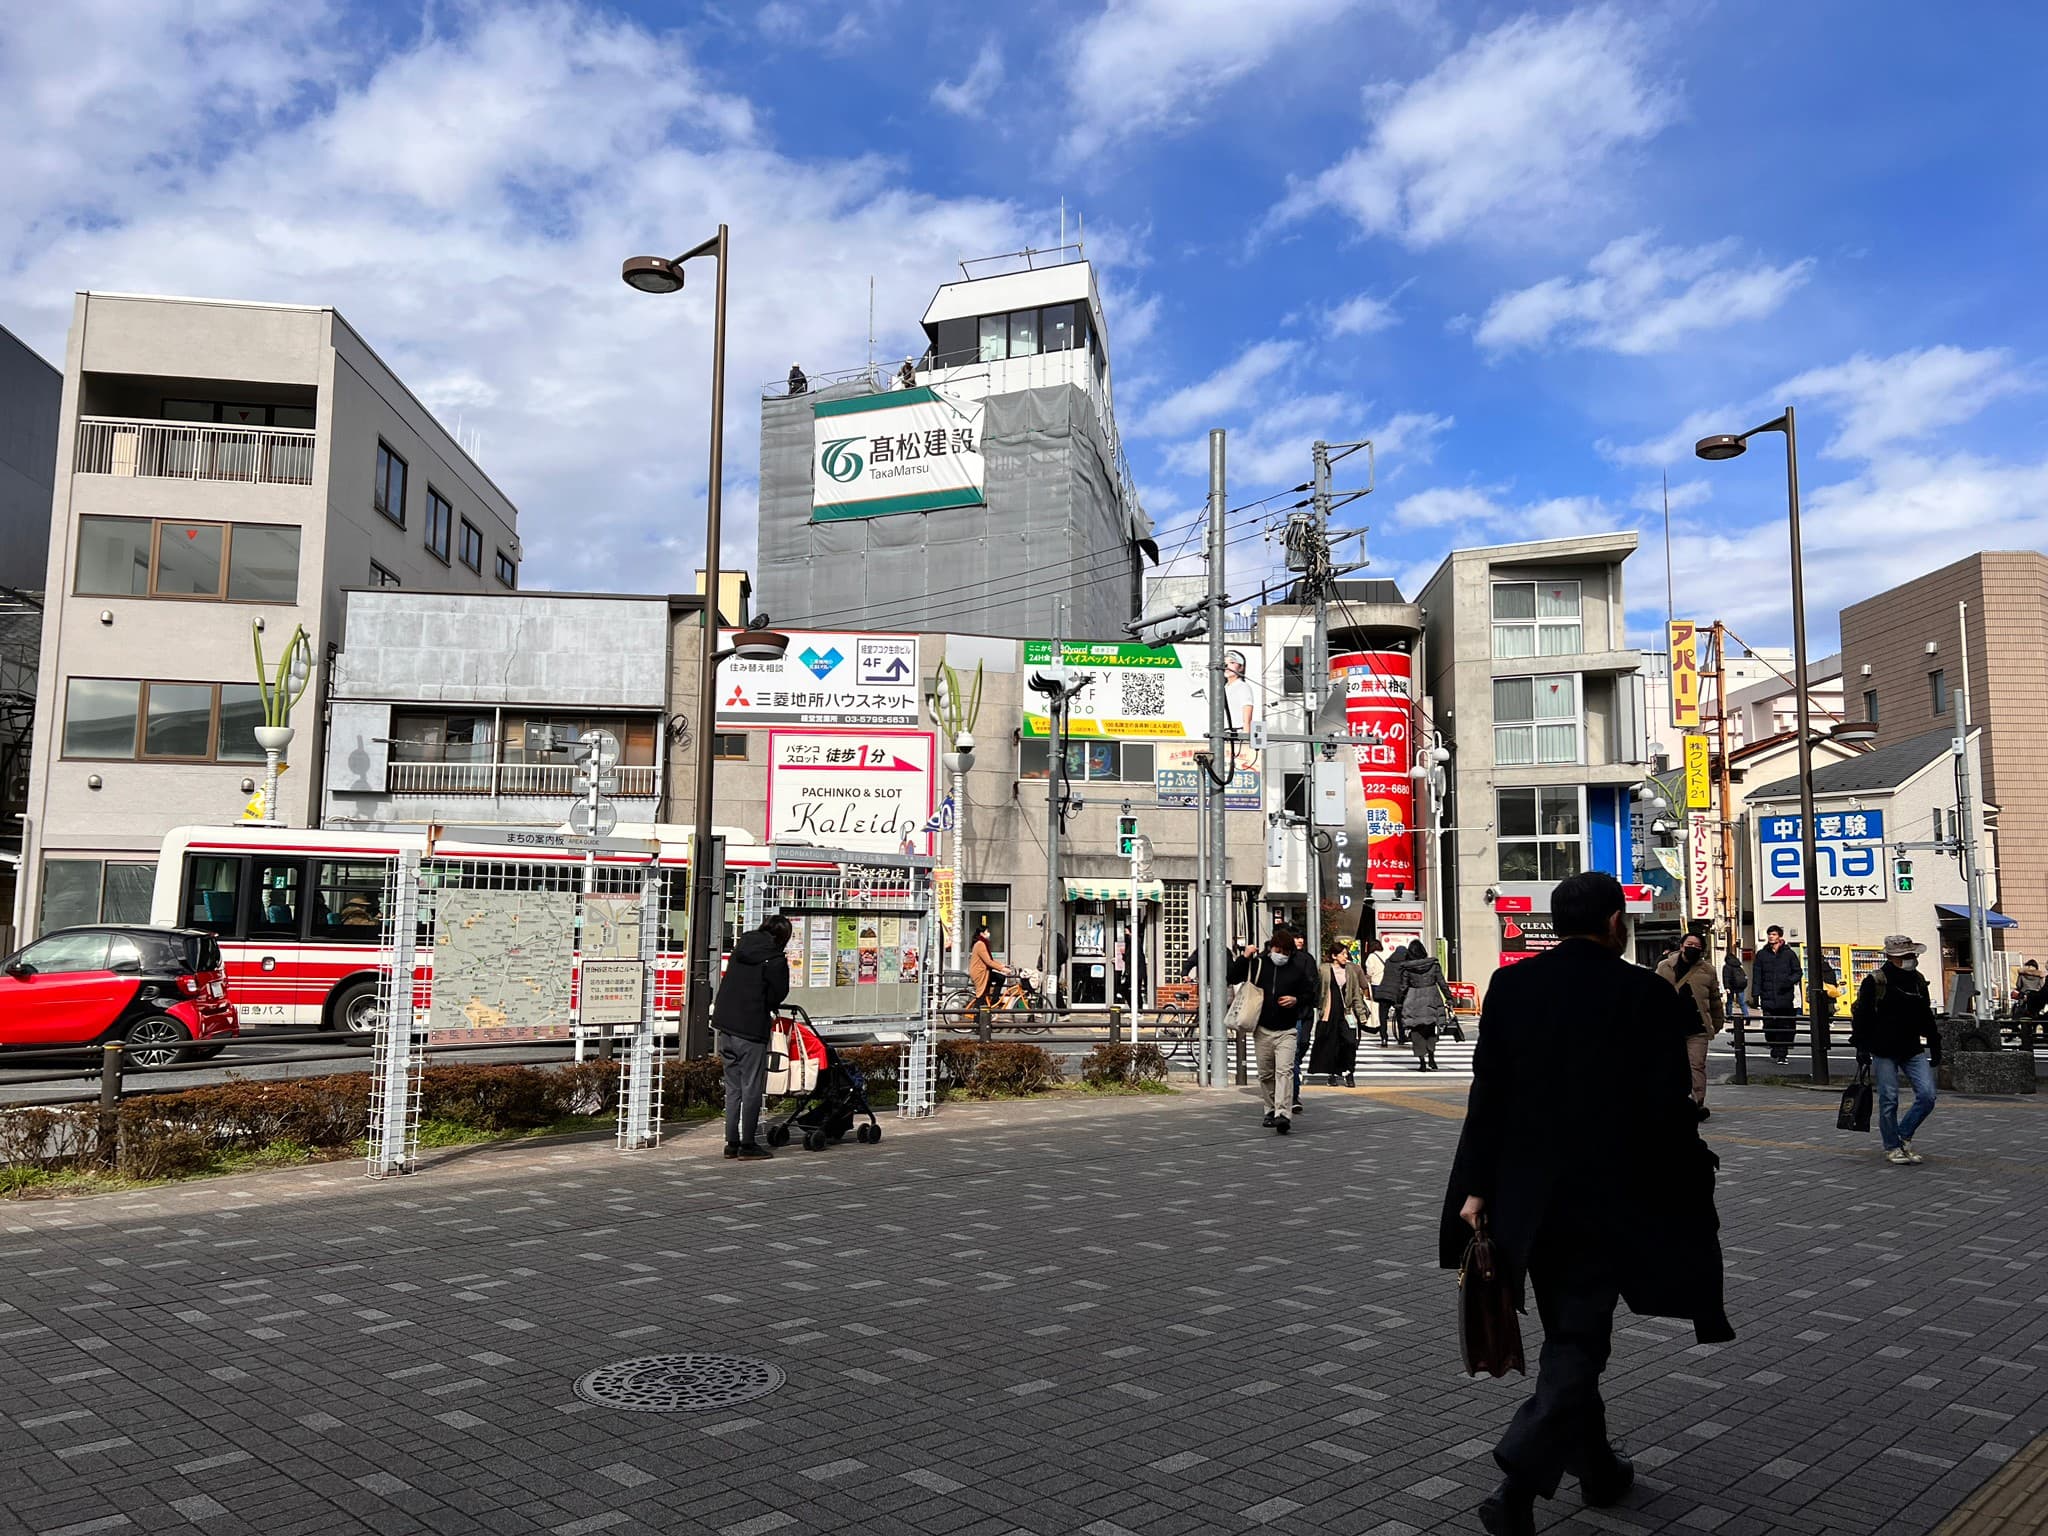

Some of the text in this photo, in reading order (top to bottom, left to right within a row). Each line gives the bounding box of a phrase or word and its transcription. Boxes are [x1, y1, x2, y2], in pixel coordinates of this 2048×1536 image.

[729, 663, 784, 673] 住み替え相談
[863, 657, 881, 667] 4F
[1672, 625, 1696, 721] アパート
[756, 692, 914, 709] 三菱地所ハウスネット
[786, 745, 820, 753] パチンコ
[787, 755, 819, 763] スロット
[802, 787, 903, 798] PACHINKO & SLOT
[1368, 822, 1405, 836] 受付中
[507, 832, 564, 846] まちの案内板
[1819, 884, 1879, 897] この先すぐ
